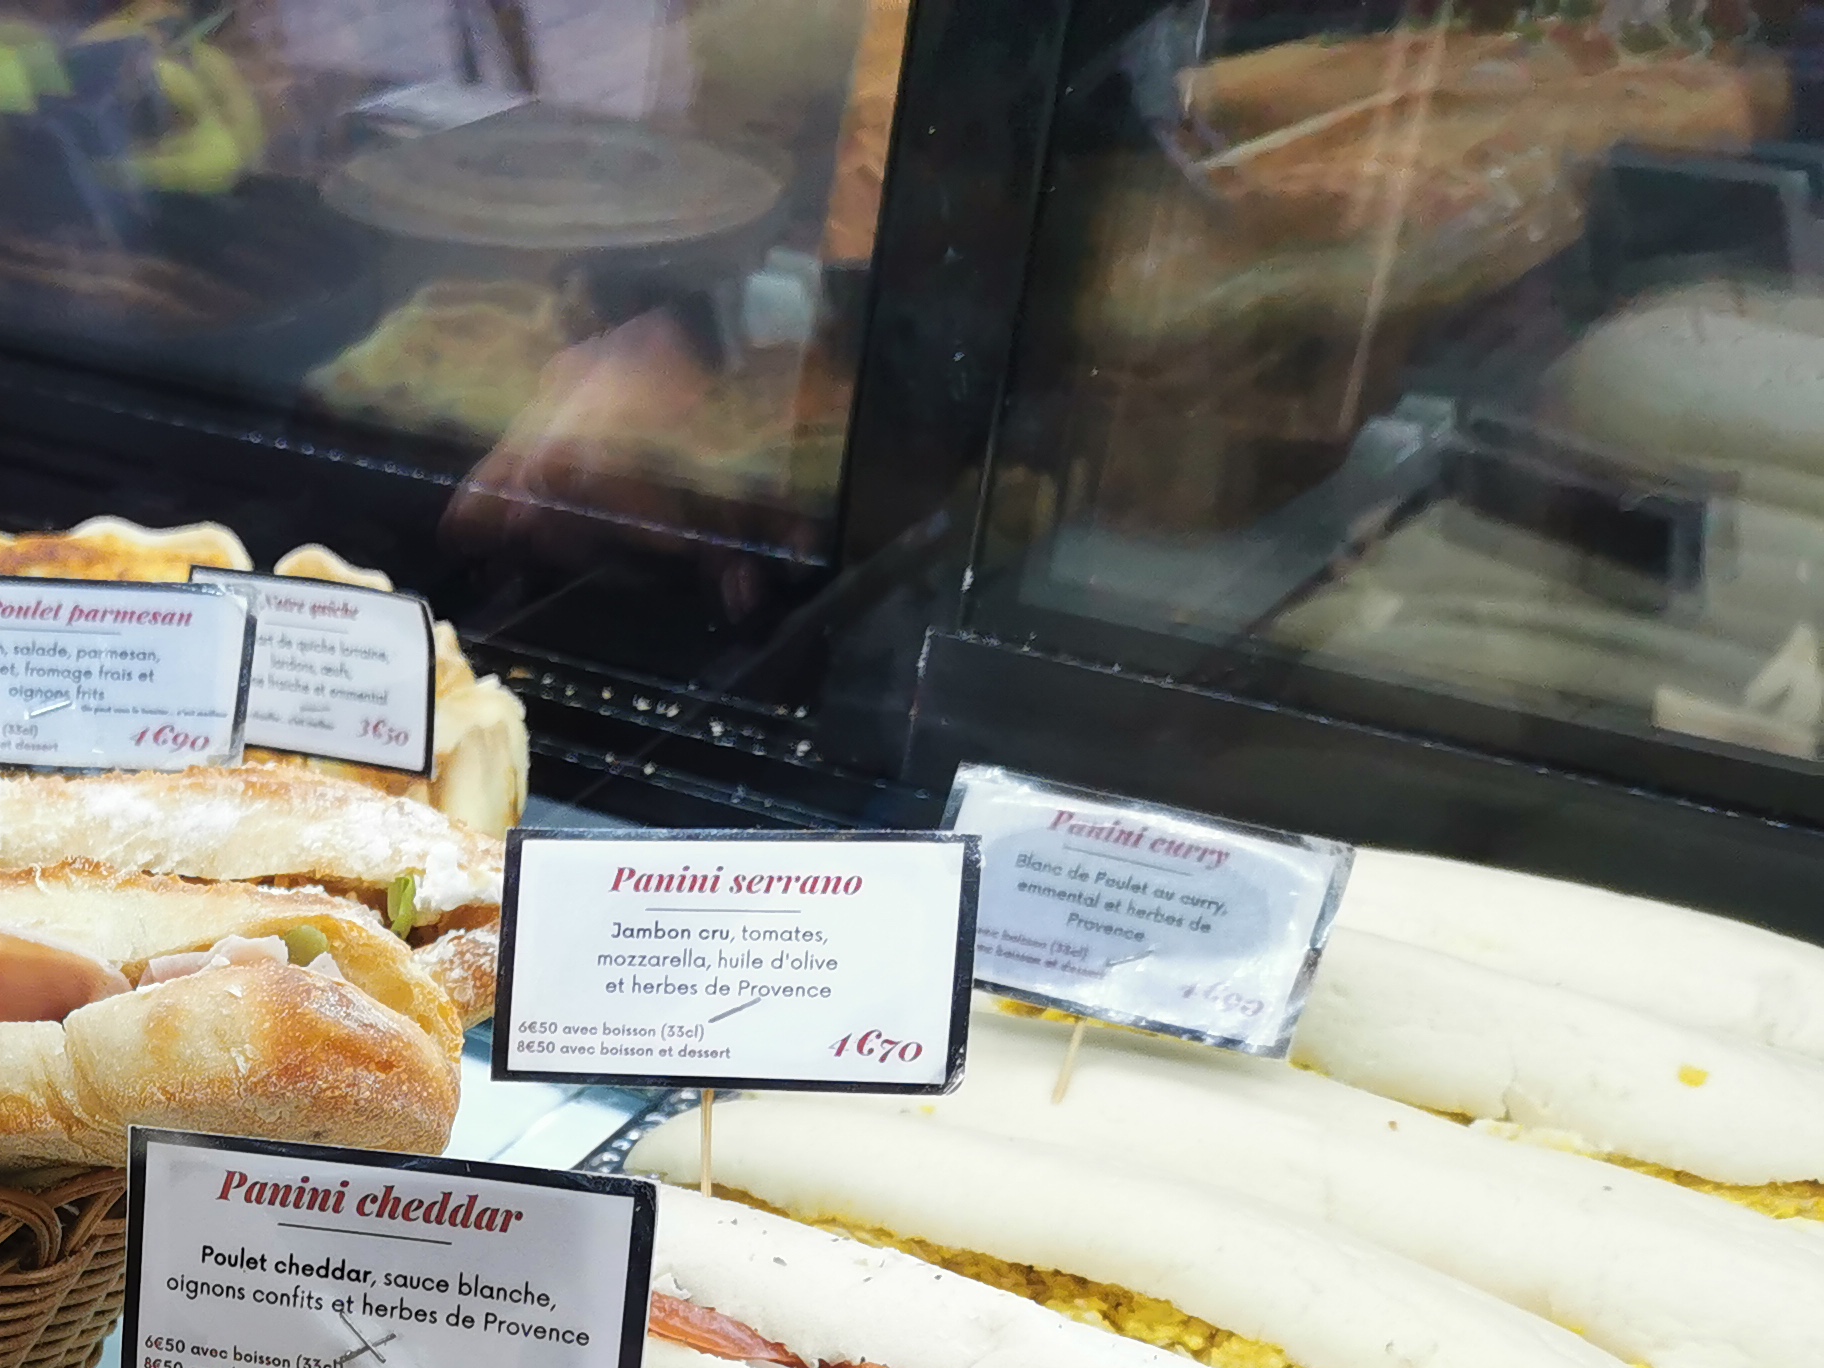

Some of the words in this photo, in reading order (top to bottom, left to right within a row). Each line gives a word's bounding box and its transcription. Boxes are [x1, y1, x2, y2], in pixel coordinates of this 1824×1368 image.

[66, 603, 194, 628] parmesan
[12, 641, 72, 660] salade,
[75, 646, 161, 665] parmesan,
[23, 662, 93, 684] fromage
[97, 663, 134, 683] frais
[138, 668, 155, 683] et
[8, 683, 71, 702] oignons
[75, 682, 105, 701] frits
[1046, 808, 1146, 850] Panini
[1149, 836, 1231, 870] curry
[609, 865, 724, 894] Panini
[728, 873, 864, 896] serrano
[1014, 853, 1063, 877] Blanc
[1067, 863, 1090, 884] de
[1093, 869, 1148, 895] Poulet
[1153, 886, 1175, 902] au
[1179, 891, 1229, 917] curry,
[1016, 880, 1100, 912] emmental
[1103, 899, 1122, 915] et
[1125, 900, 1185, 927] herbes
[1189, 915, 1212, 934] de
[610, 921, 692, 941] Jambon
[698, 926, 736, 945] cru,
[741, 923, 829, 946] tomates,
[1066, 911, 1146, 943] Provence
[597, 949, 713, 972] mozzarella,
[717, 951, 764, 970] huile
[770, 951, 839, 972] d'olive
[605, 978, 626, 995] et
[631, 976, 698, 997] herbes
[704, 977, 731, 998] de
[737, 979, 832, 999] Provence
[517, 1020, 559, 1036] 6€50
[562, 1024, 599, 1037] avec
[602, 1021, 657, 1039] boisson
[660, 1022, 706, 1042] (33cl)
[516, 1040, 557, 1056] 8€50
[559, 1044, 596, 1057] avec
[599, 1041, 655, 1058] boisson
[658, 1045, 675, 1059] et
[677, 1043, 732, 1060] dessert
[828, 1028, 923, 1064] 4€70
[216, 1168, 350, 1216] Panini
[355, 1184, 524, 1234] cheddar
[200, 1244, 268, 1273] Poulet
[273, 1254, 377, 1288] cheddar,
[383, 1269, 450, 1294] sauce
[457, 1273, 558, 1311] blanche,
[166, 1273, 246, 1302] oignons
[252, 1282, 324, 1313] confits
[331, 1295, 355, 1316] et
[362, 1299, 438, 1326] herbes
[445, 1308, 476, 1331] de
[483, 1311, 591, 1347] Provence
[144, 1334, 186, 1355] 6€50
[190, 1344, 229, 1361] avec
